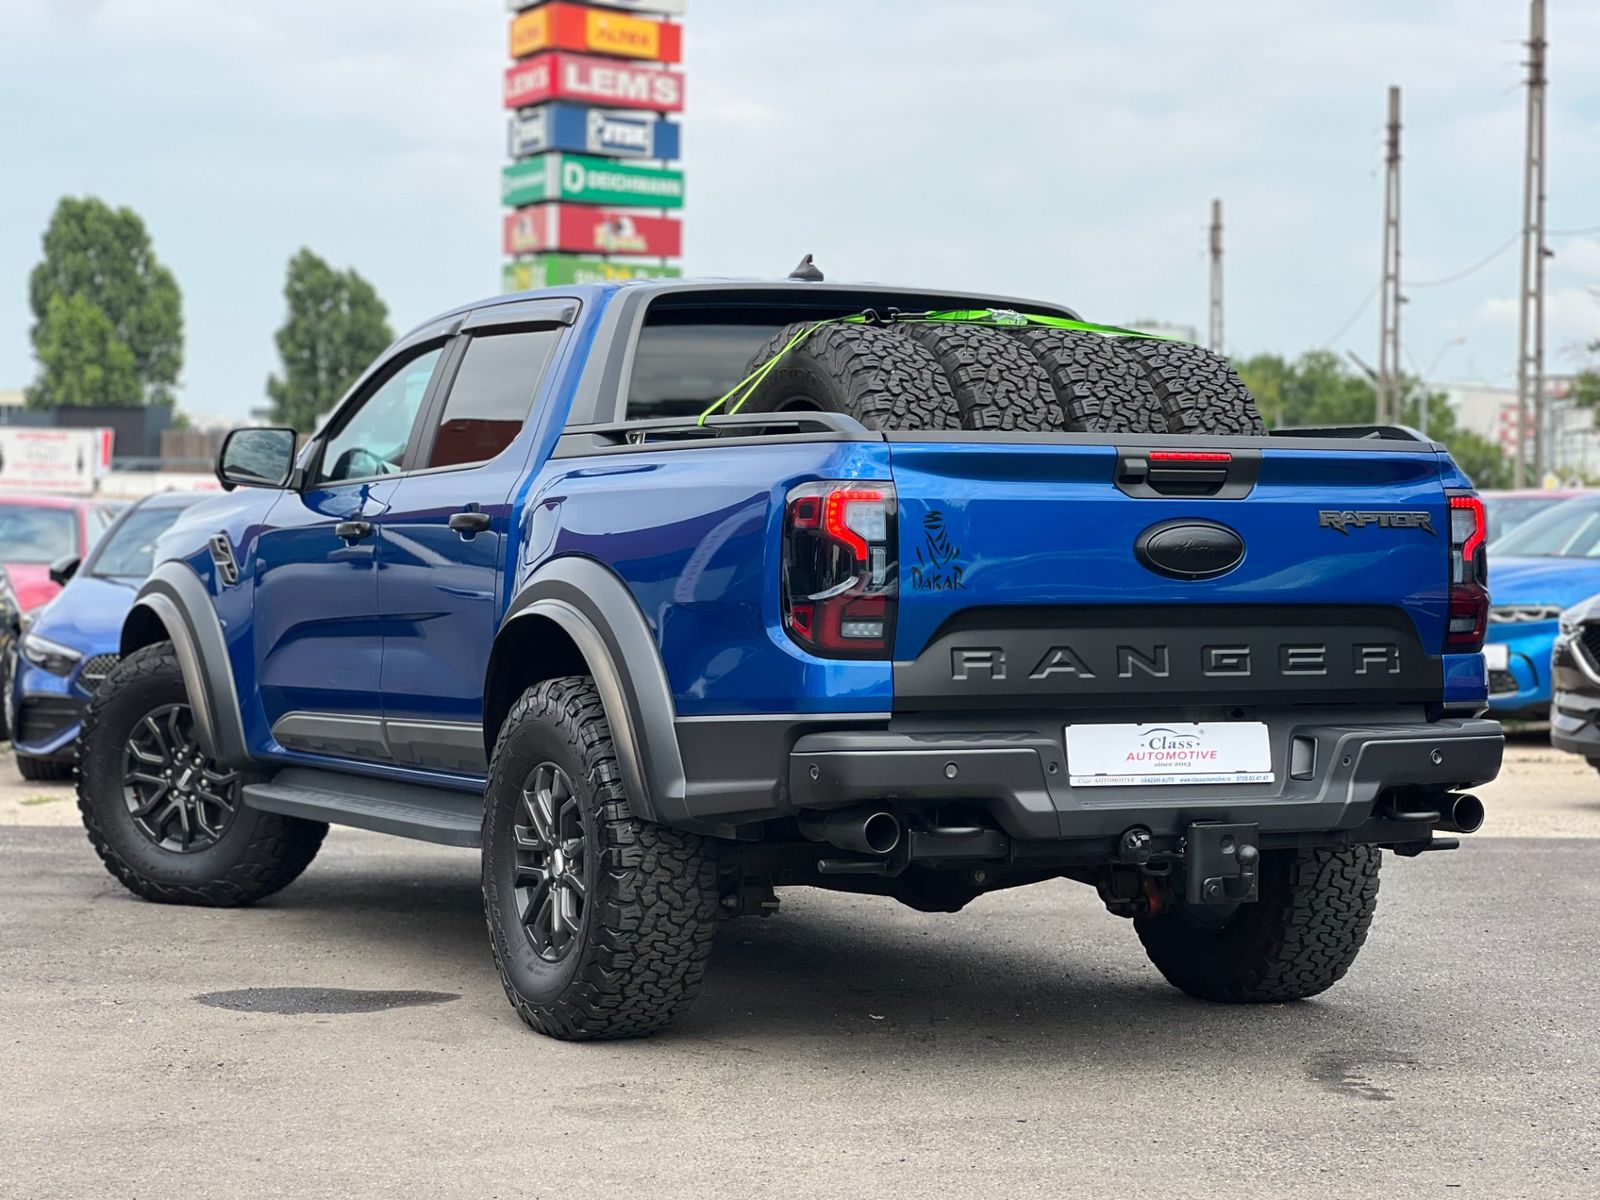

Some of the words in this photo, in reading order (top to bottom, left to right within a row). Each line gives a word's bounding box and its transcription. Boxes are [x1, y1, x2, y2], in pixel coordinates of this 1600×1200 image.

[564, 63, 679, 104] LEM'S
[1318, 509, 1438, 538] RAPTOR
[911, 566, 967, 592] DAKAR
[950, 644, 1401, 681] RANGER
[1125, 750, 1219, 762] AUTOMOTIVE
[1148, 735, 1194, 751] Class
[1153, 760, 1173, 768] since
